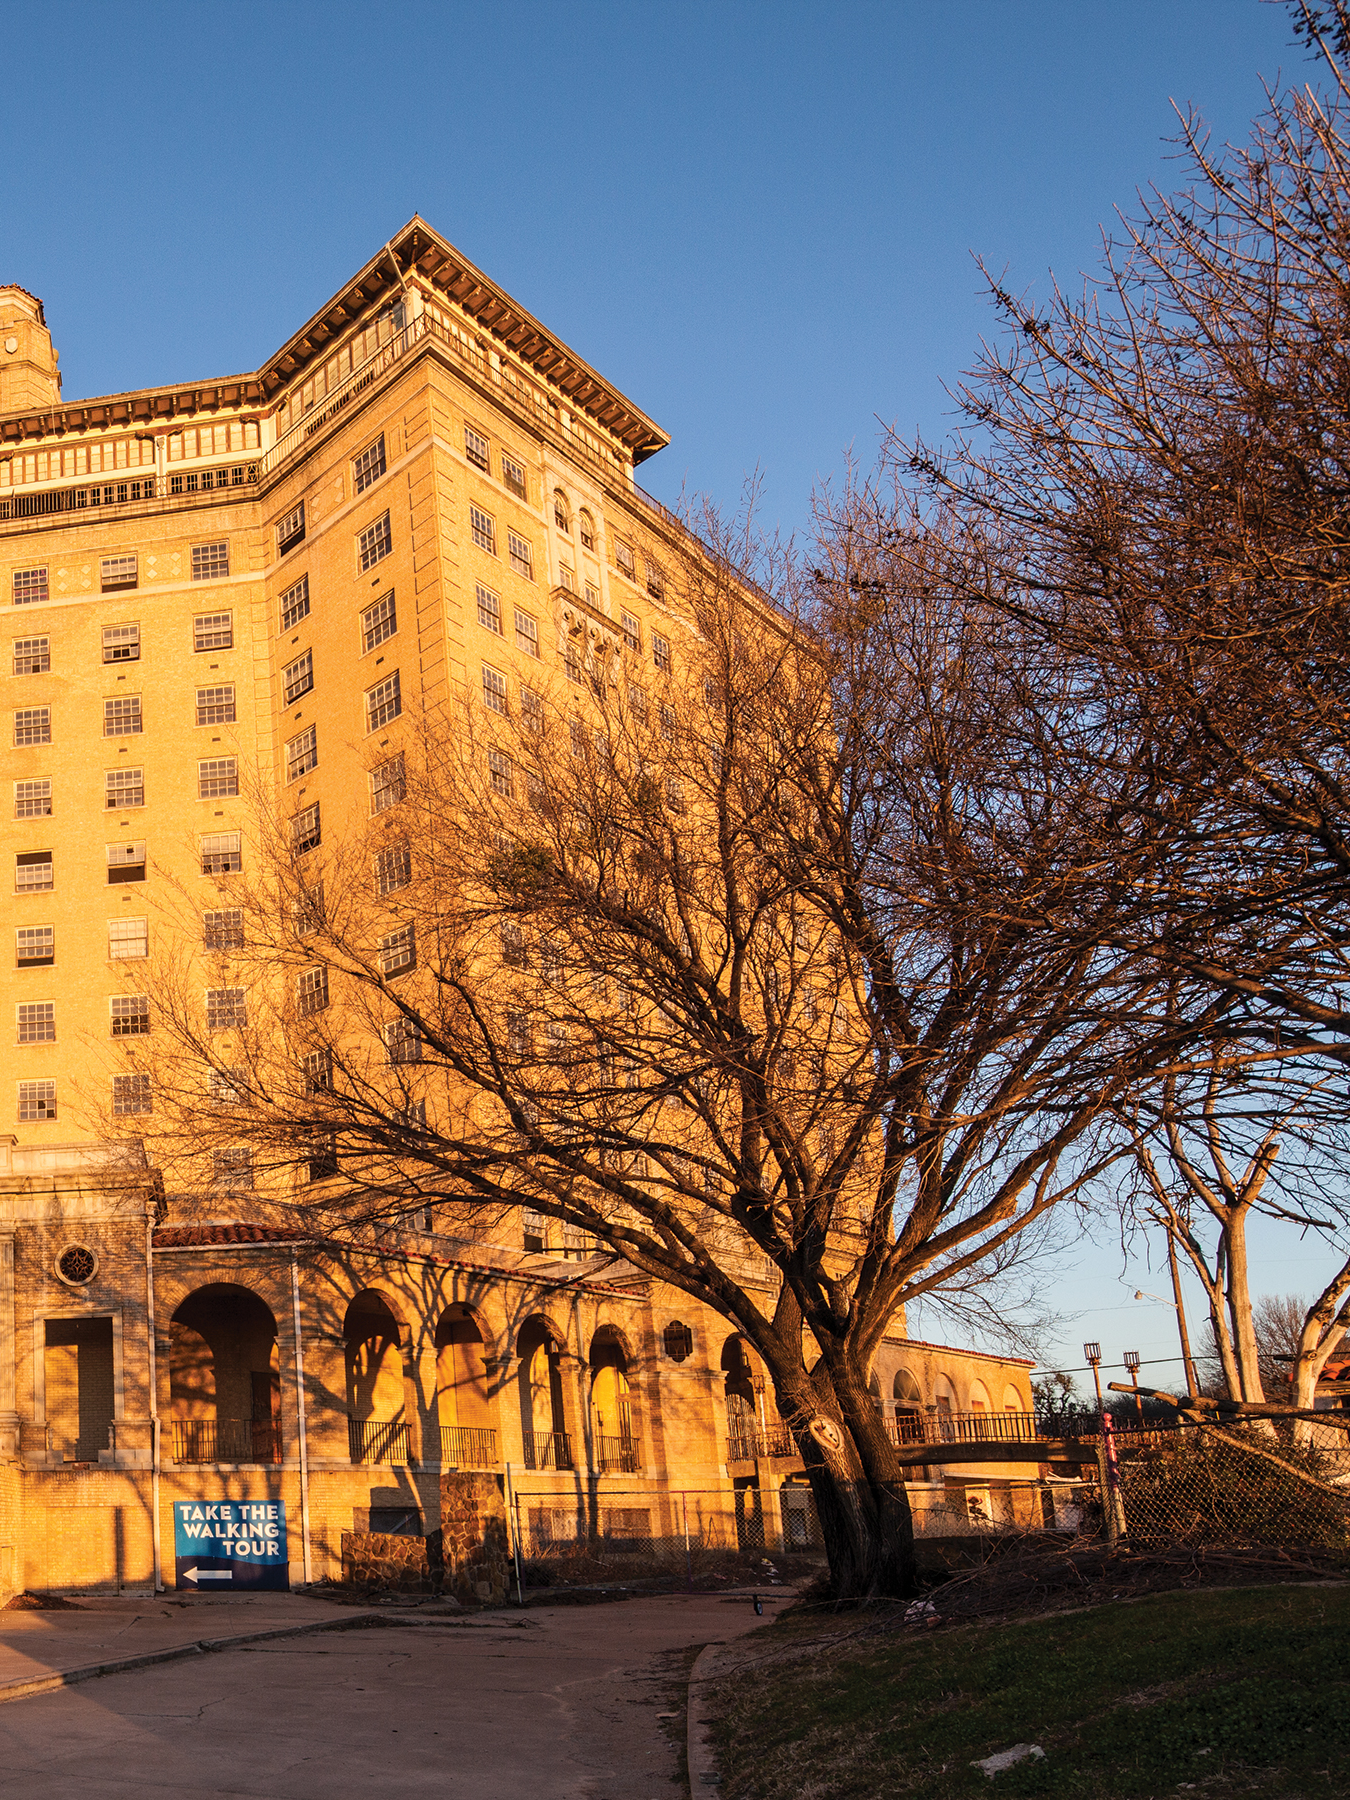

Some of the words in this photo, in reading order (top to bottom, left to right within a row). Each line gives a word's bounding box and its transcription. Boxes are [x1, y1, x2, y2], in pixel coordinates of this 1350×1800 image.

[179, 1505, 231, 1520] TAKE
[238, 1505, 278, 1520] THE
[183, 1523, 280, 1538] WALKING
[222, 1541, 280, 1556] TOUR
